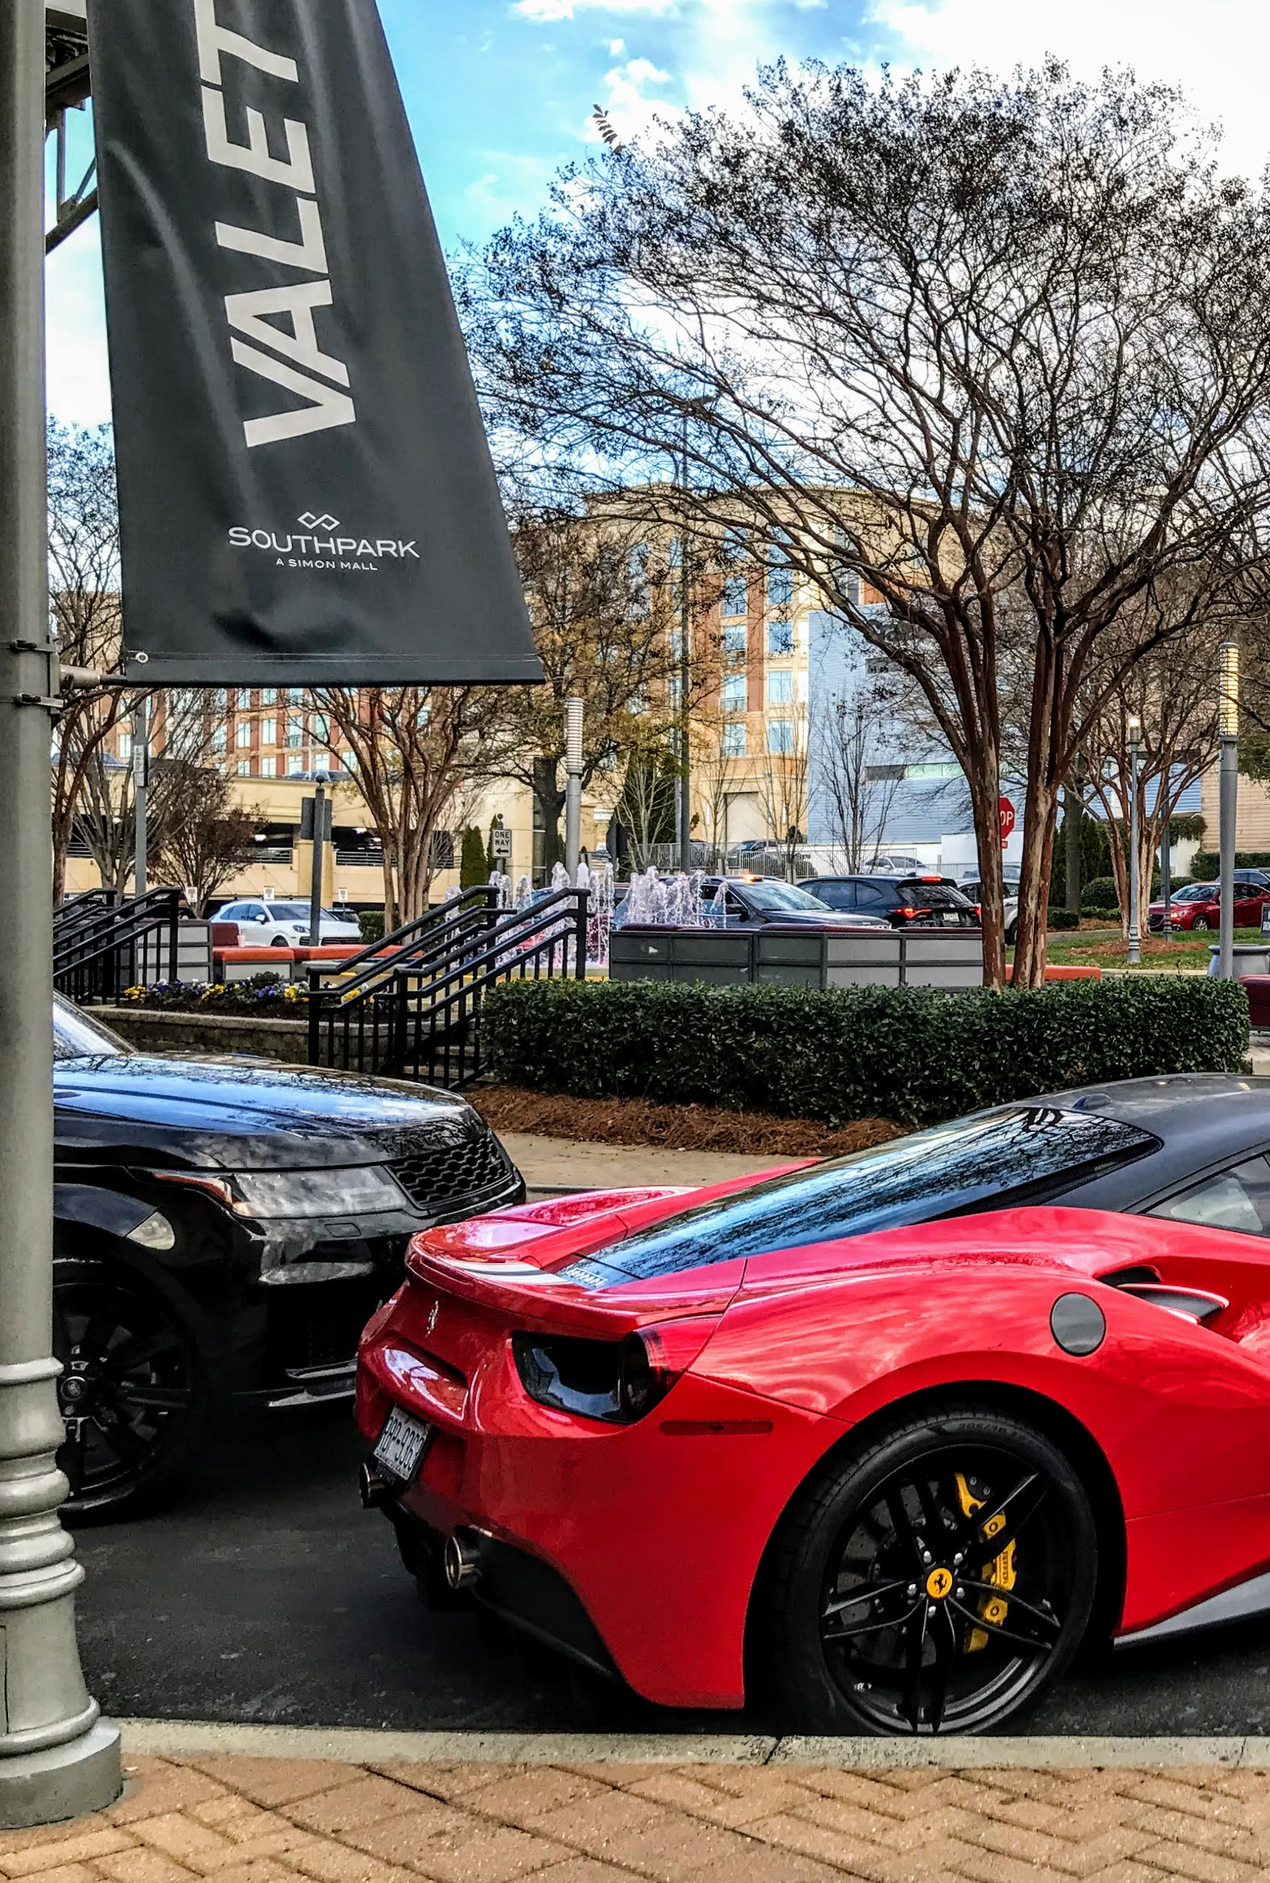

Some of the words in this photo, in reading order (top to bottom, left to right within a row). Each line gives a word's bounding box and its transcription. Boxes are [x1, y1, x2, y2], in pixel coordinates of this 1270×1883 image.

[194, 0, 356, 448] VALET
[228, 526, 421, 559] SOUTHPARK
[275, 557, 285, 567] A
[288, 558, 336, 569] SIMON
[340, 561, 378, 571] MALL
[494, 831, 510, 839] ONE
[494, 839, 510, 847] WAY
